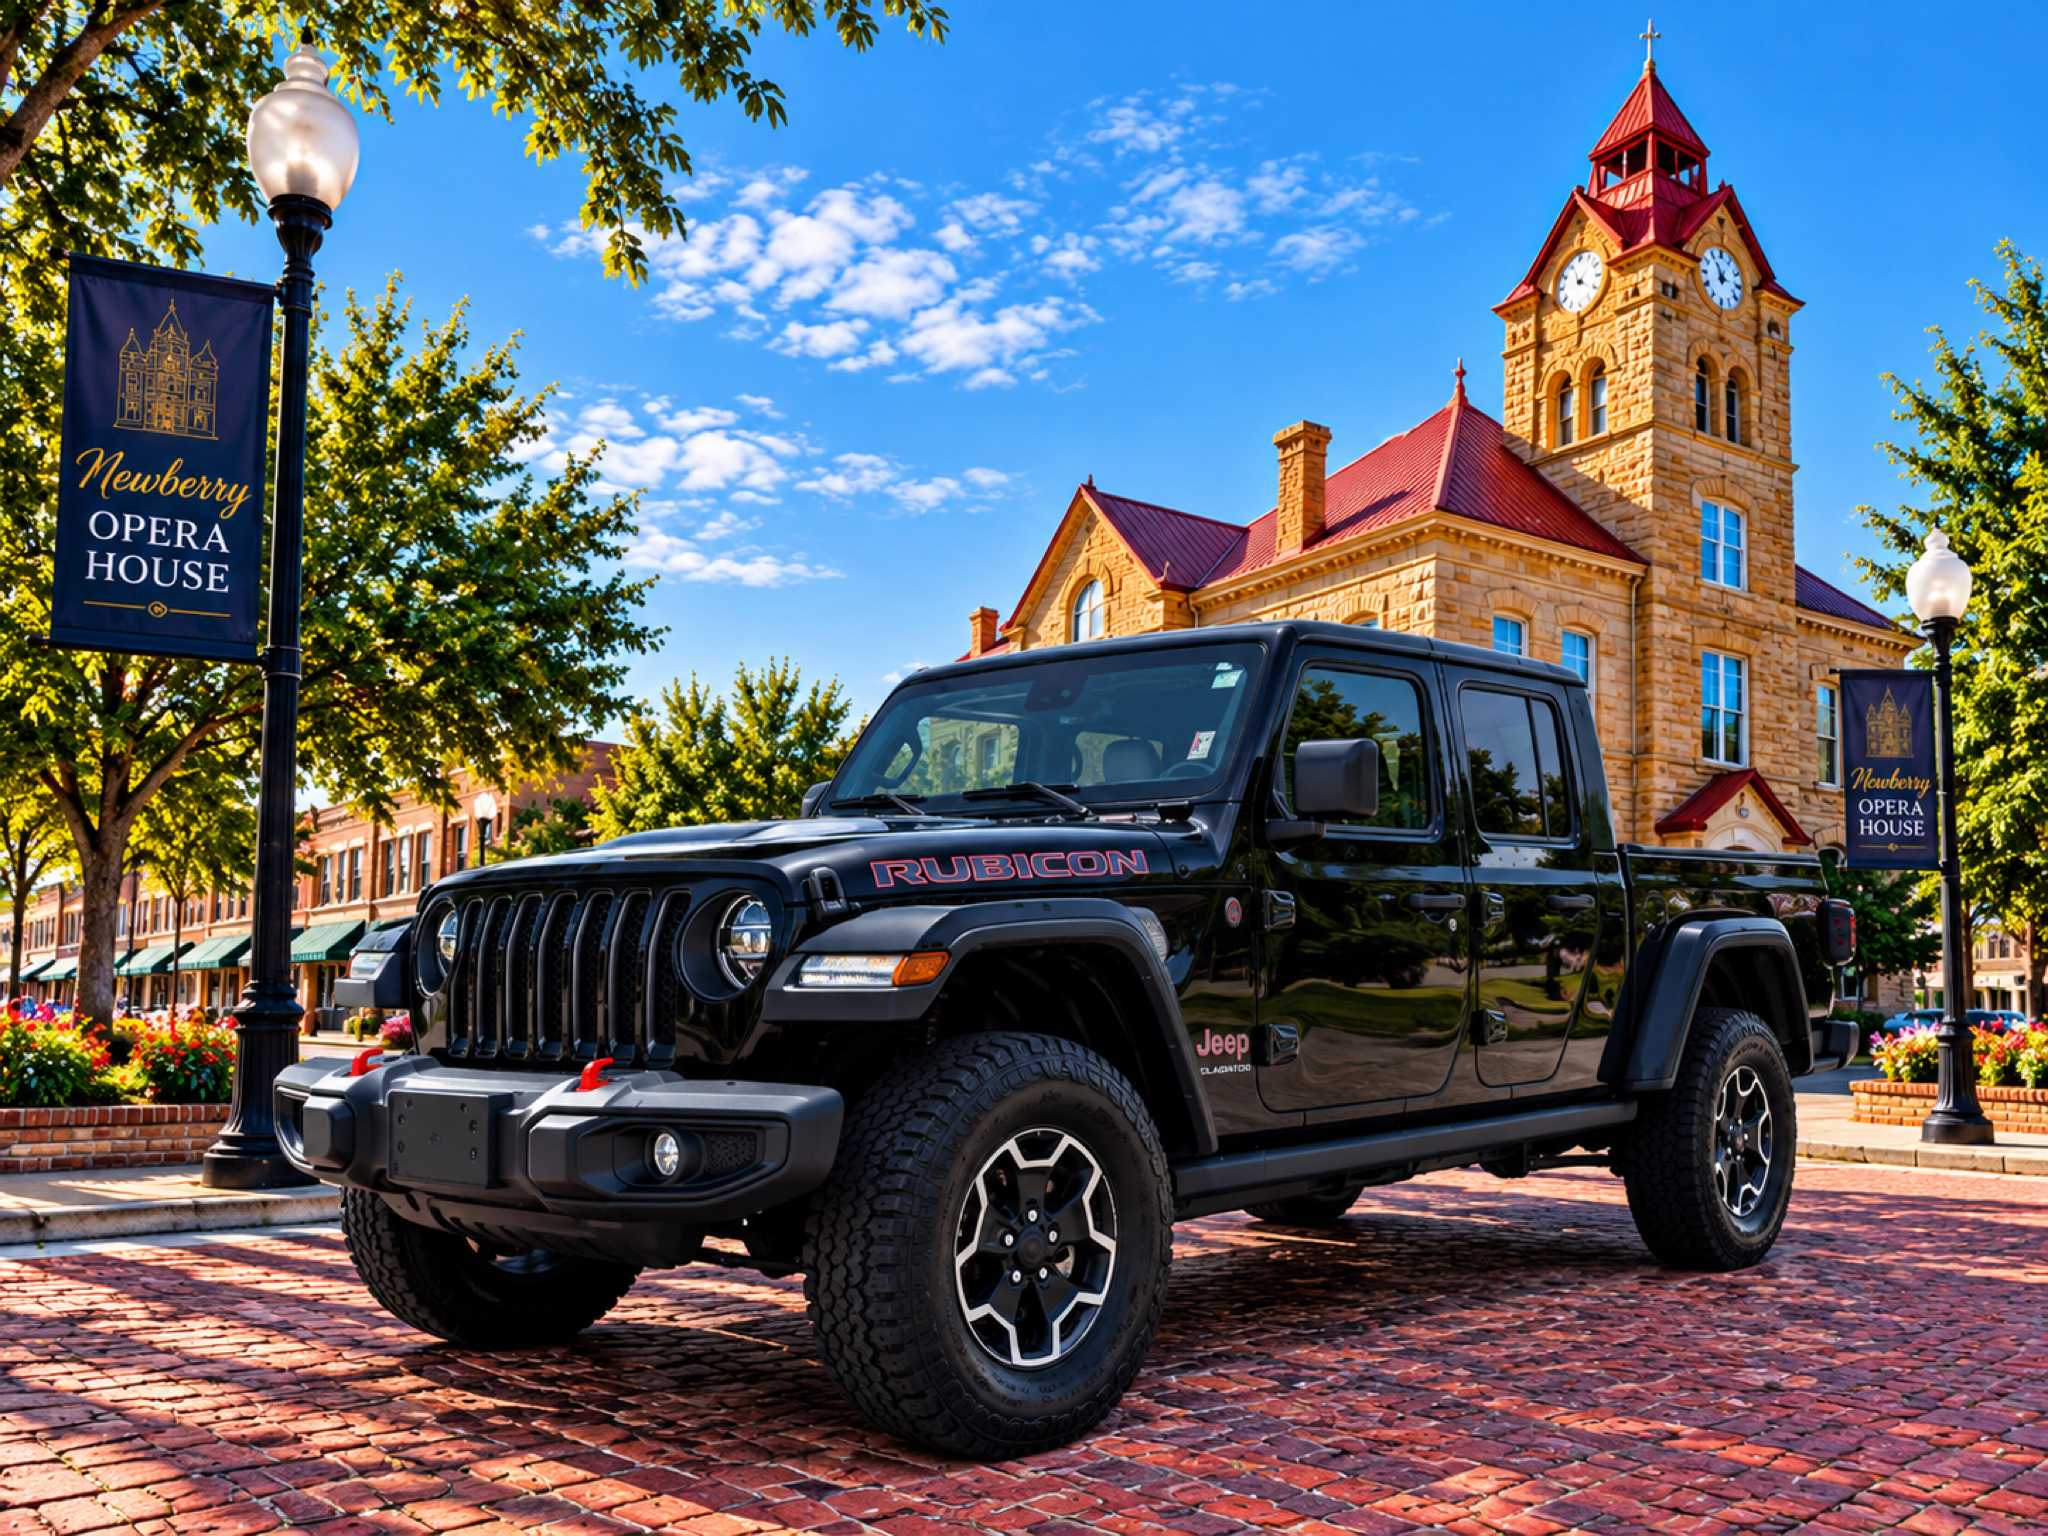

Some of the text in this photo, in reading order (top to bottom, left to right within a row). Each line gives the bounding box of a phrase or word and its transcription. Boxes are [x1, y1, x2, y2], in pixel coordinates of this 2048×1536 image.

[75, 447, 251, 519] Newberry
[88, 510, 230, 553] OPERA
[85, 550, 230, 594] HOUSE
[1850, 766, 1932, 799] Newberry
[1858, 798, 1924, 816] OPERA
[1859, 818, 1925, 837] HOUSE
[870, 850, 1149, 888] RUBICON
[1196, 1028, 1250, 1061] Jeep
